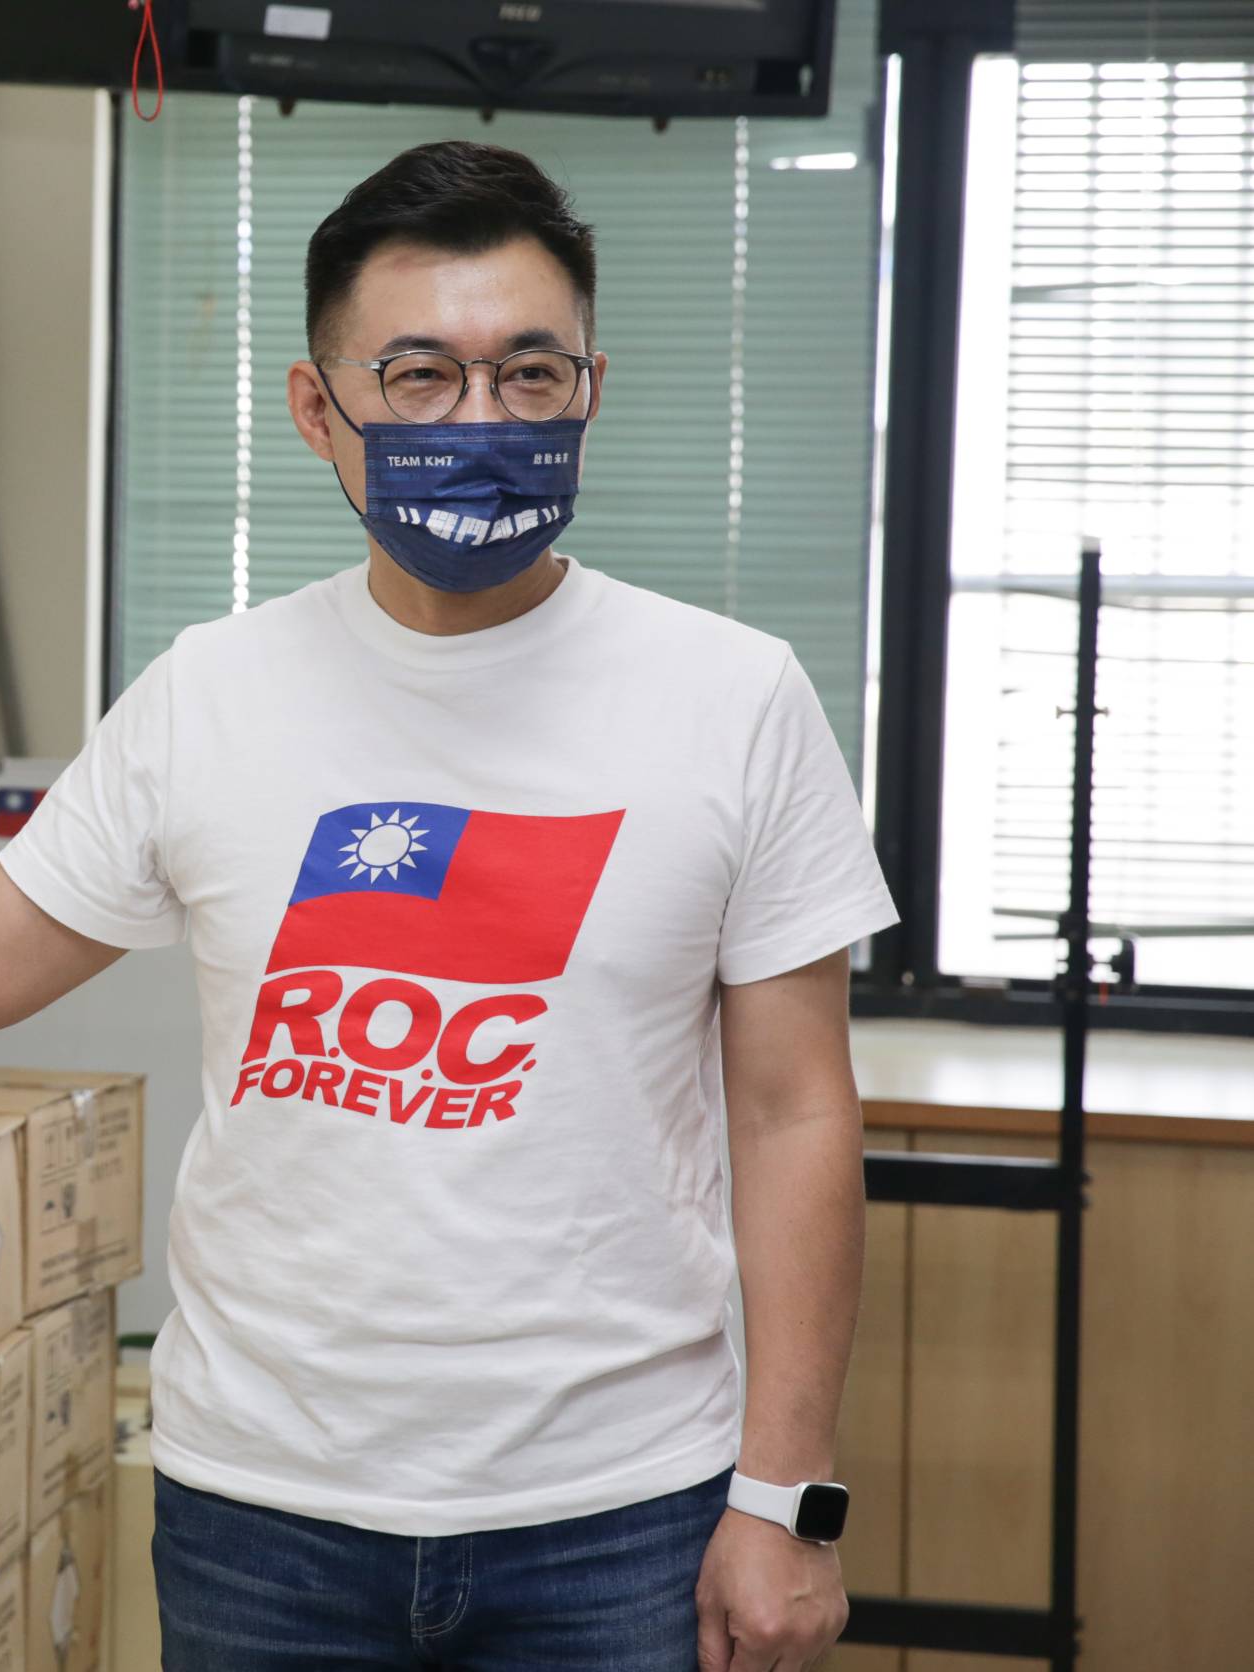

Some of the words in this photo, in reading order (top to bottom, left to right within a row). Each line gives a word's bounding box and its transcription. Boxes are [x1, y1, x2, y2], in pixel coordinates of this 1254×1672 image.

[387, 455, 421, 467] TEAM
[425, 455, 454, 467] KMT
[241, 969, 548, 1085] R.O.C.
[230, 1059, 523, 1129] FOREVER
